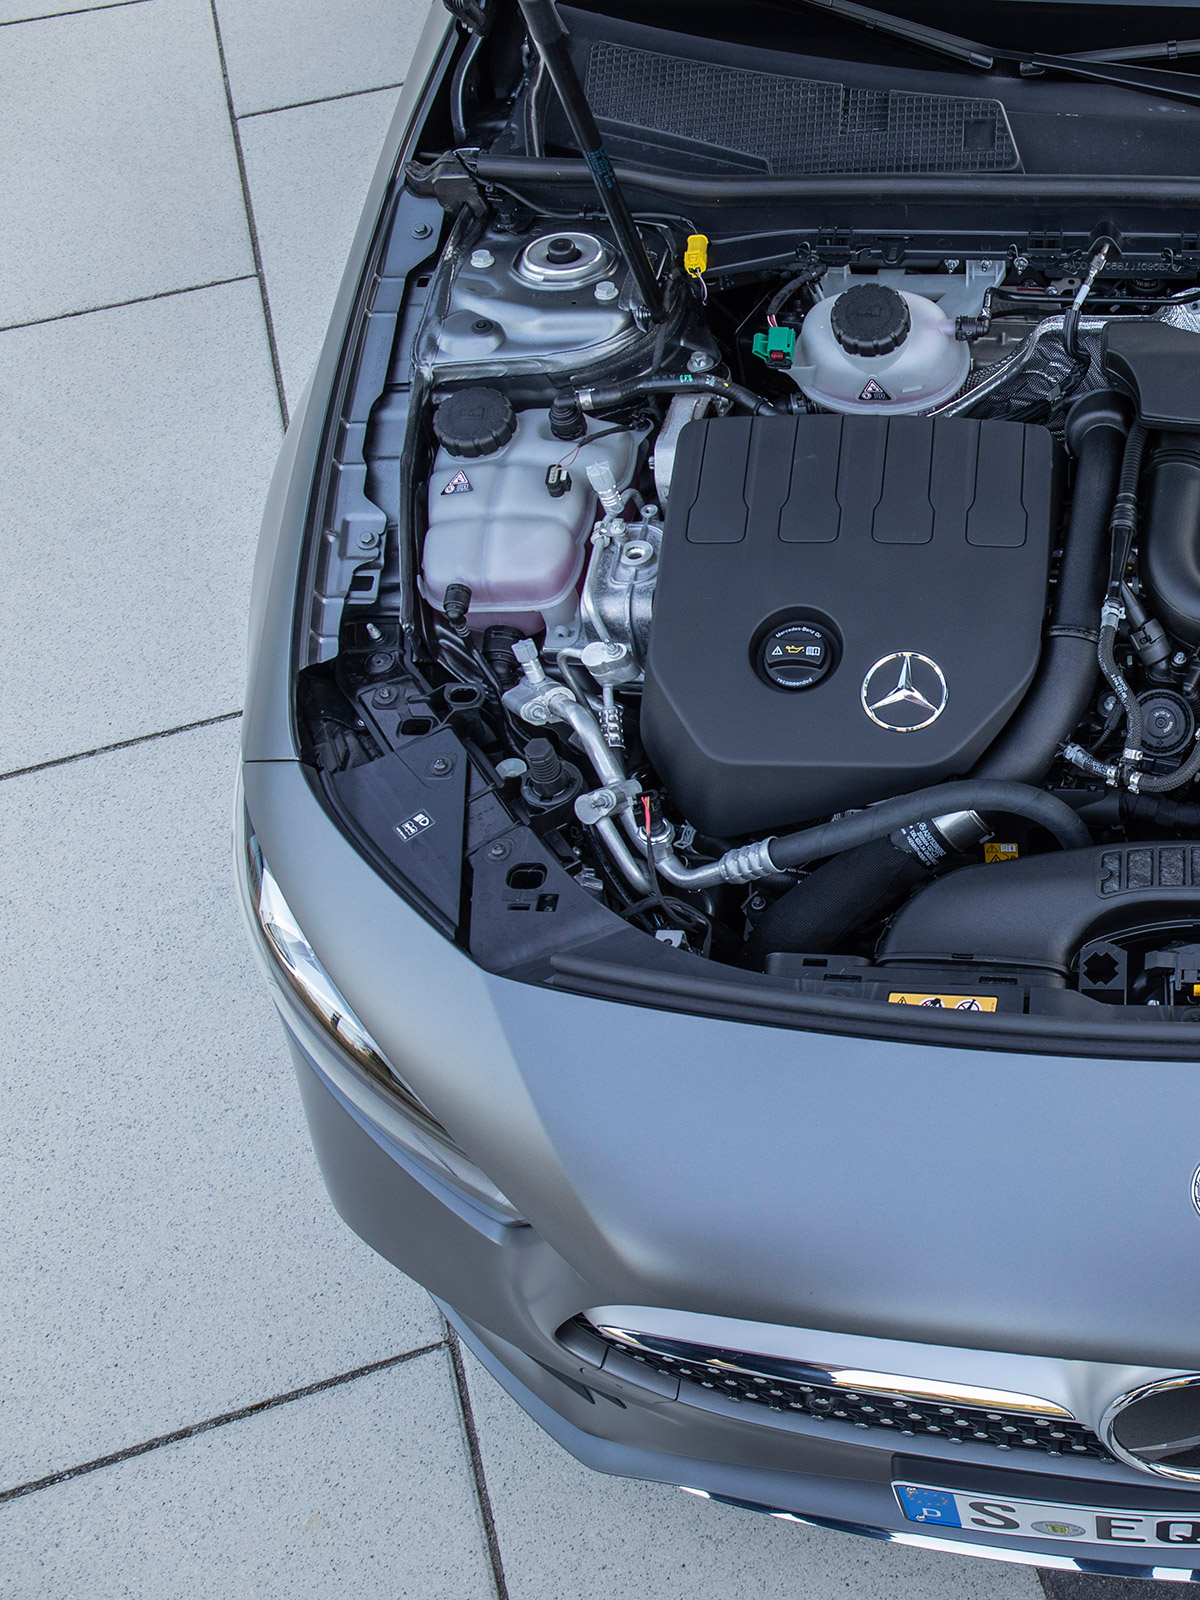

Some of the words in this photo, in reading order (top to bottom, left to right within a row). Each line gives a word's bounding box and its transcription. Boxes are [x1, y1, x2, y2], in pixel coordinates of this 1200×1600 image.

[776, 677, 813, 686] recommended
[922, 1507, 941, 1518] D
[968, 1501, 1020, 1530] S
